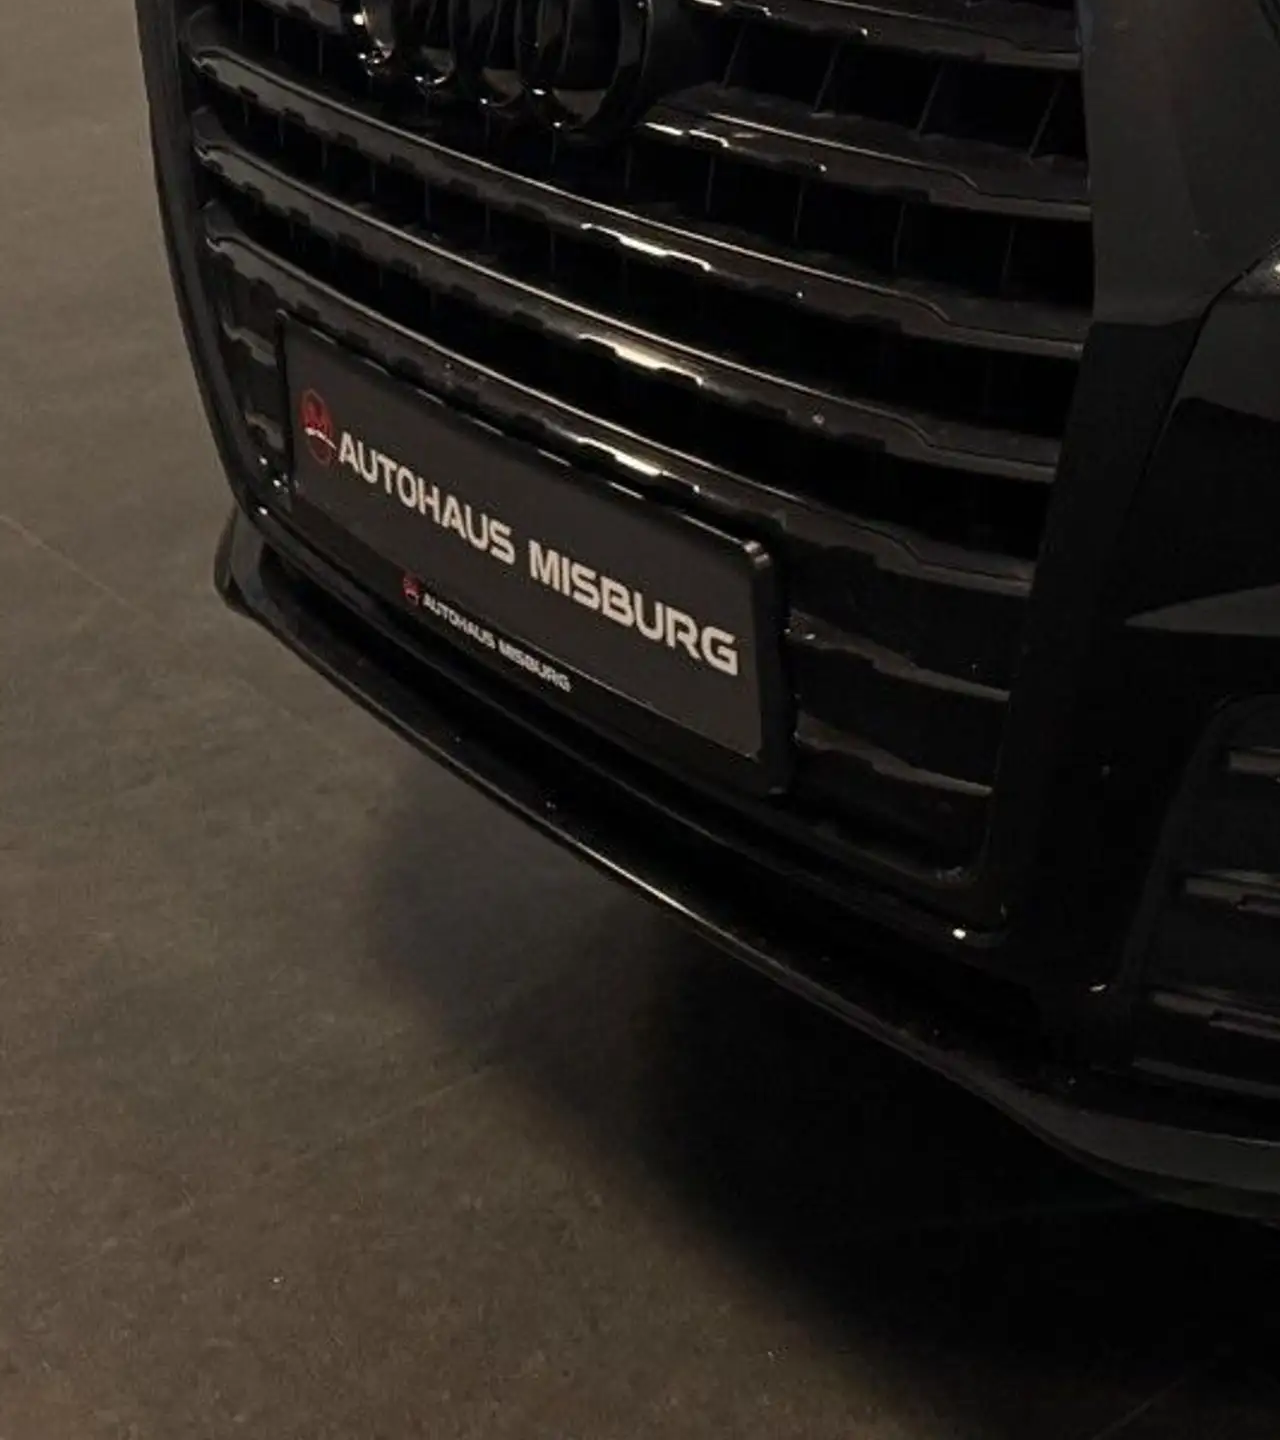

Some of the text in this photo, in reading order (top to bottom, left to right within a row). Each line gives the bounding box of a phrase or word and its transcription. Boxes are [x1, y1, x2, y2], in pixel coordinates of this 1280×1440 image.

[338, 431, 739, 677] AUTOHAUS MISBURG
[423, 592, 572, 693] AUTOHAUS MISBURG
